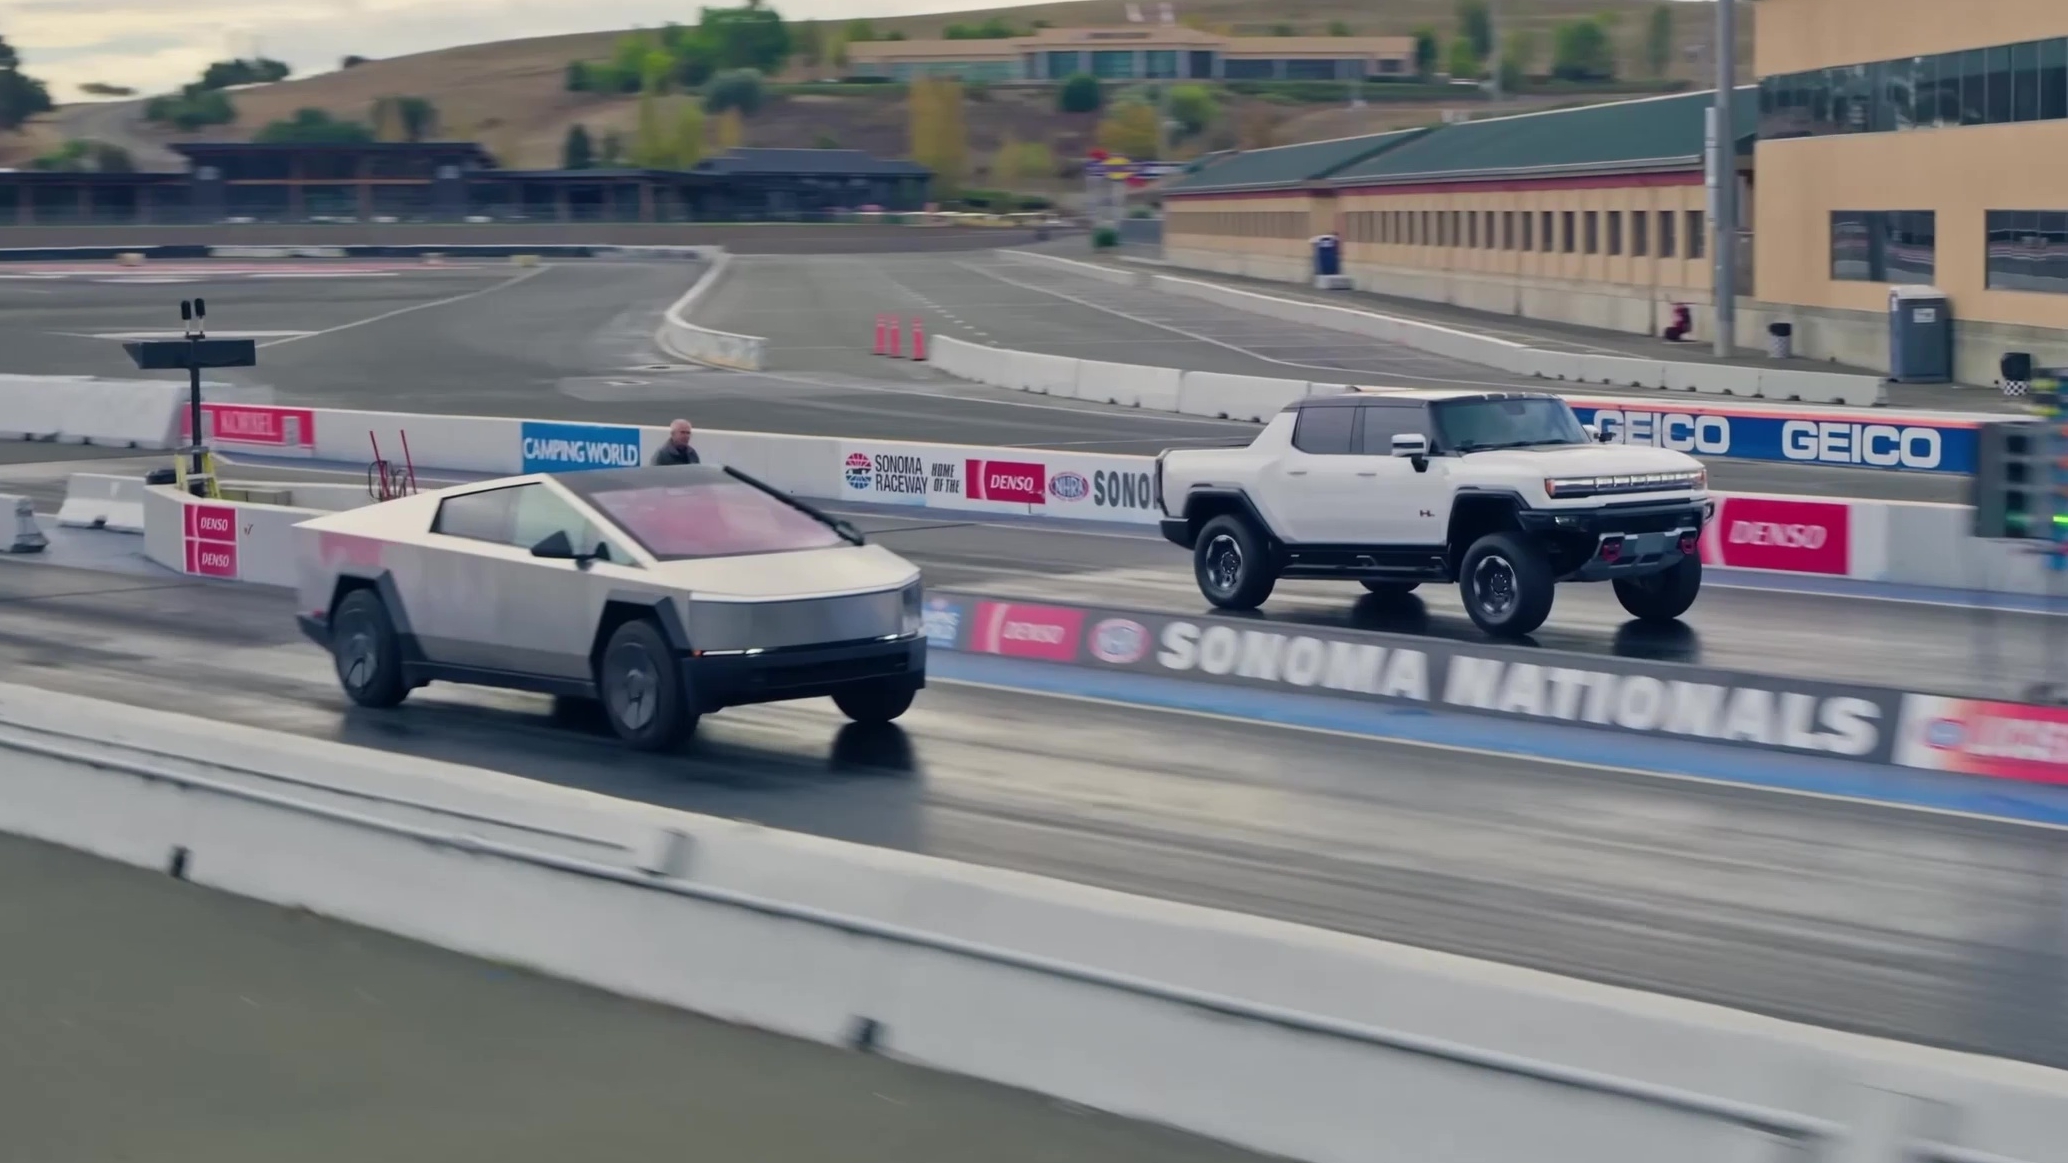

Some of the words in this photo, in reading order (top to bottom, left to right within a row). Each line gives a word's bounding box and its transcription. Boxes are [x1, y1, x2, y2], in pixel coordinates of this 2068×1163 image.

[1594, 410, 1730, 454] GEICO
[524, 437, 585, 463] CAMPING
[586, 441, 638, 466] WORLD
[1781, 420, 1941, 469] GEICO
[875, 454, 922, 475] SONOMA
[931, 462, 954, 478] HOME
[876, 474, 928, 494] RACEWAY
[933, 478, 944, 492] OF
[945, 479, 960, 493] THE
[990, 474, 1034, 492] DENSO
[1055, 476, 1084, 497] NHRA
[200, 516, 228, 531] DENSO
[1728, 520, 1828, 550] DENSO
[201, 552, 230, 568] DENSO
[1157, 622, 1430, 701] SONOMA
[1443, 654, 1884, 756] NATIONALS
